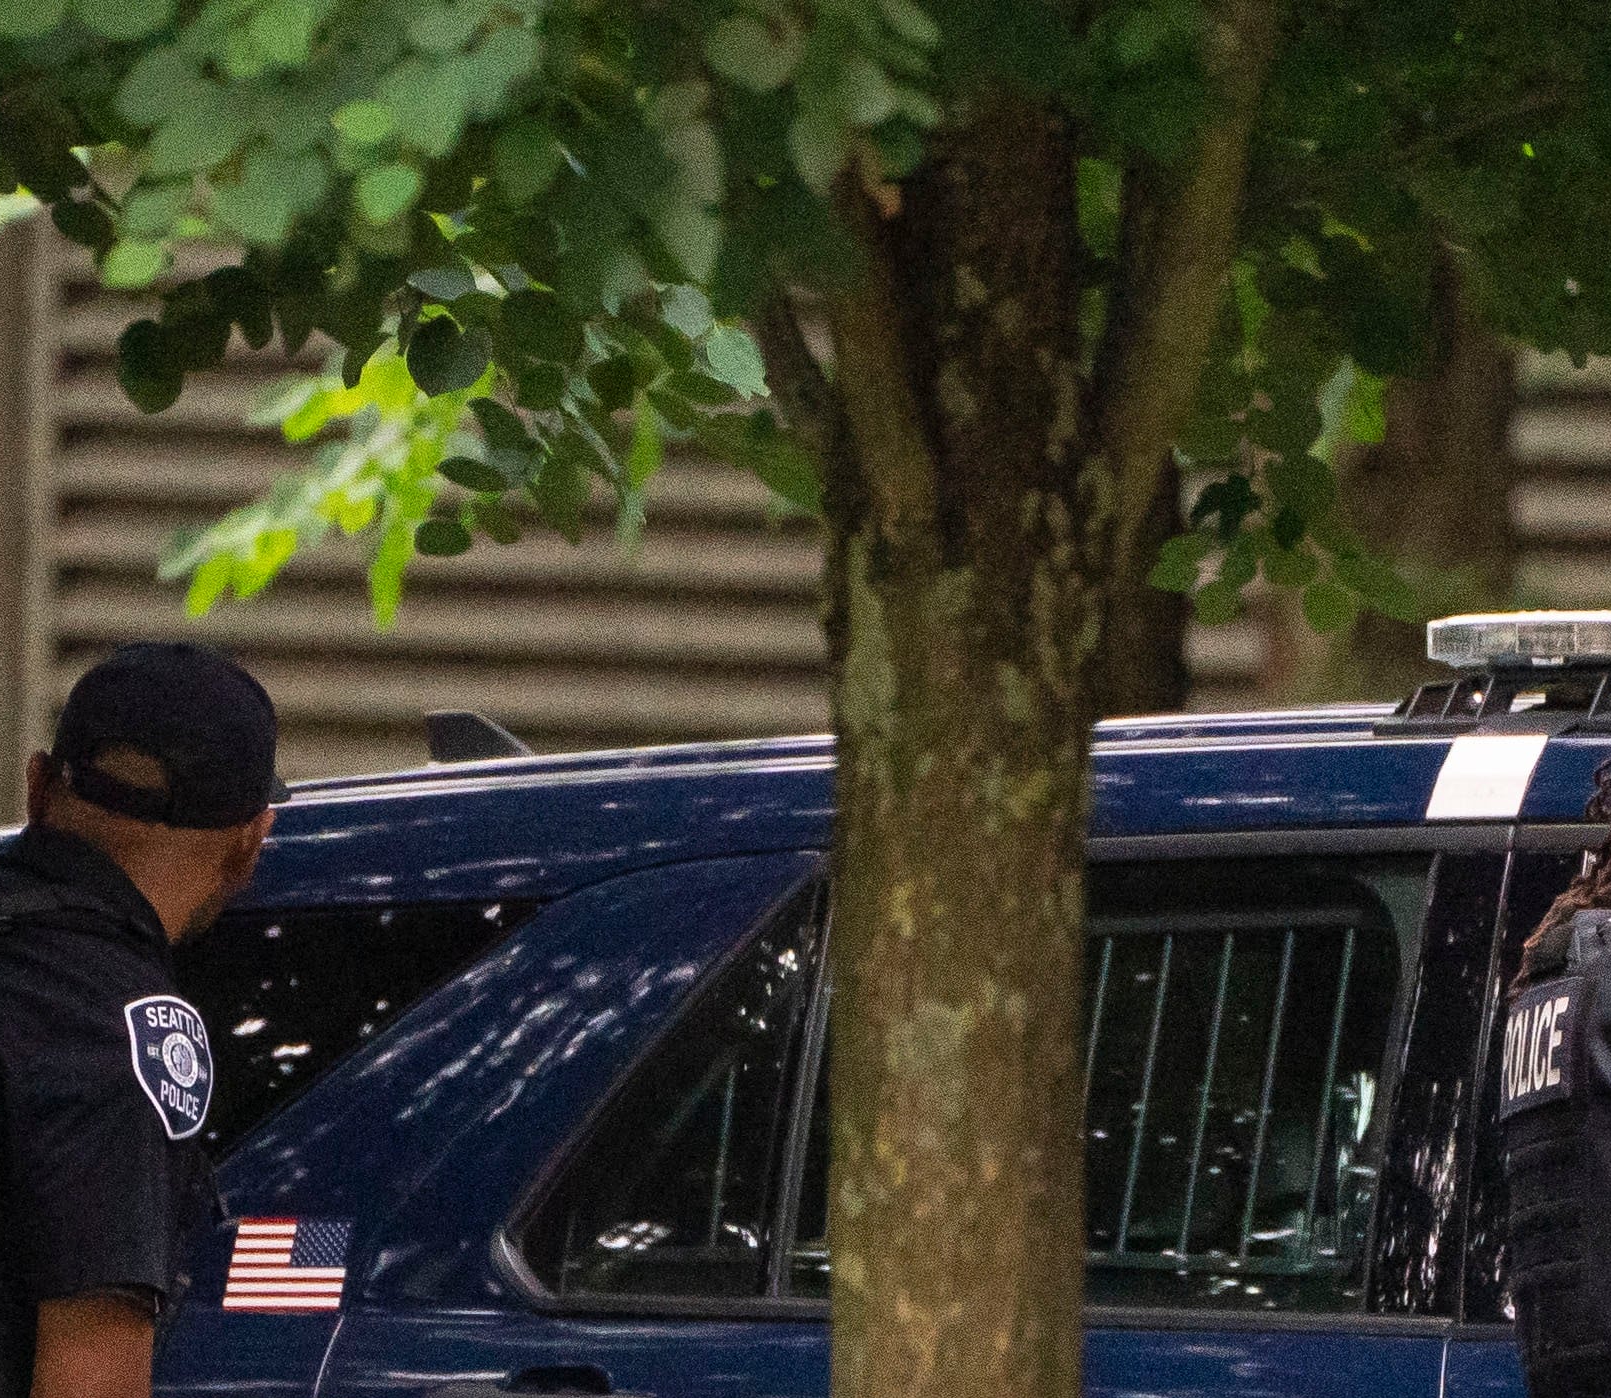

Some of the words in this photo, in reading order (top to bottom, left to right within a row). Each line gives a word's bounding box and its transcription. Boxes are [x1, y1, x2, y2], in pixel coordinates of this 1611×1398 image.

[145, 1006, 204, 1049] SEATTLE
[1501, 996, 1569, 1106] POLICE
[161, 1079, 200, 1121] POLICE
